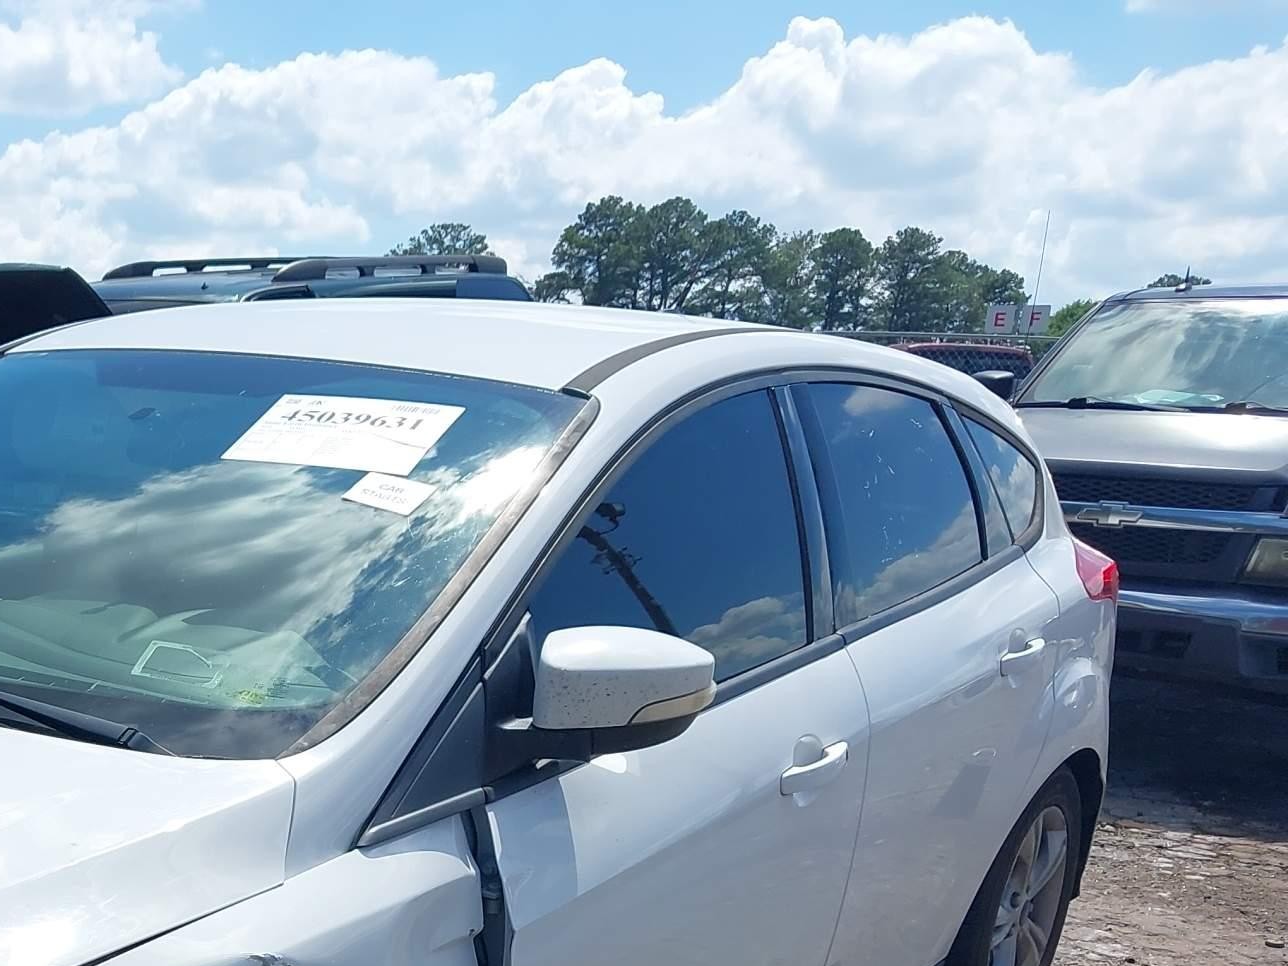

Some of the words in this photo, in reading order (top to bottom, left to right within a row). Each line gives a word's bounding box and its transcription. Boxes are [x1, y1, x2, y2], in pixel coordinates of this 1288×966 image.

[994, 312, 1007, 327] E
[1029, 311, 1042, 327] F
[280, 408, 424, 431] 45039631
